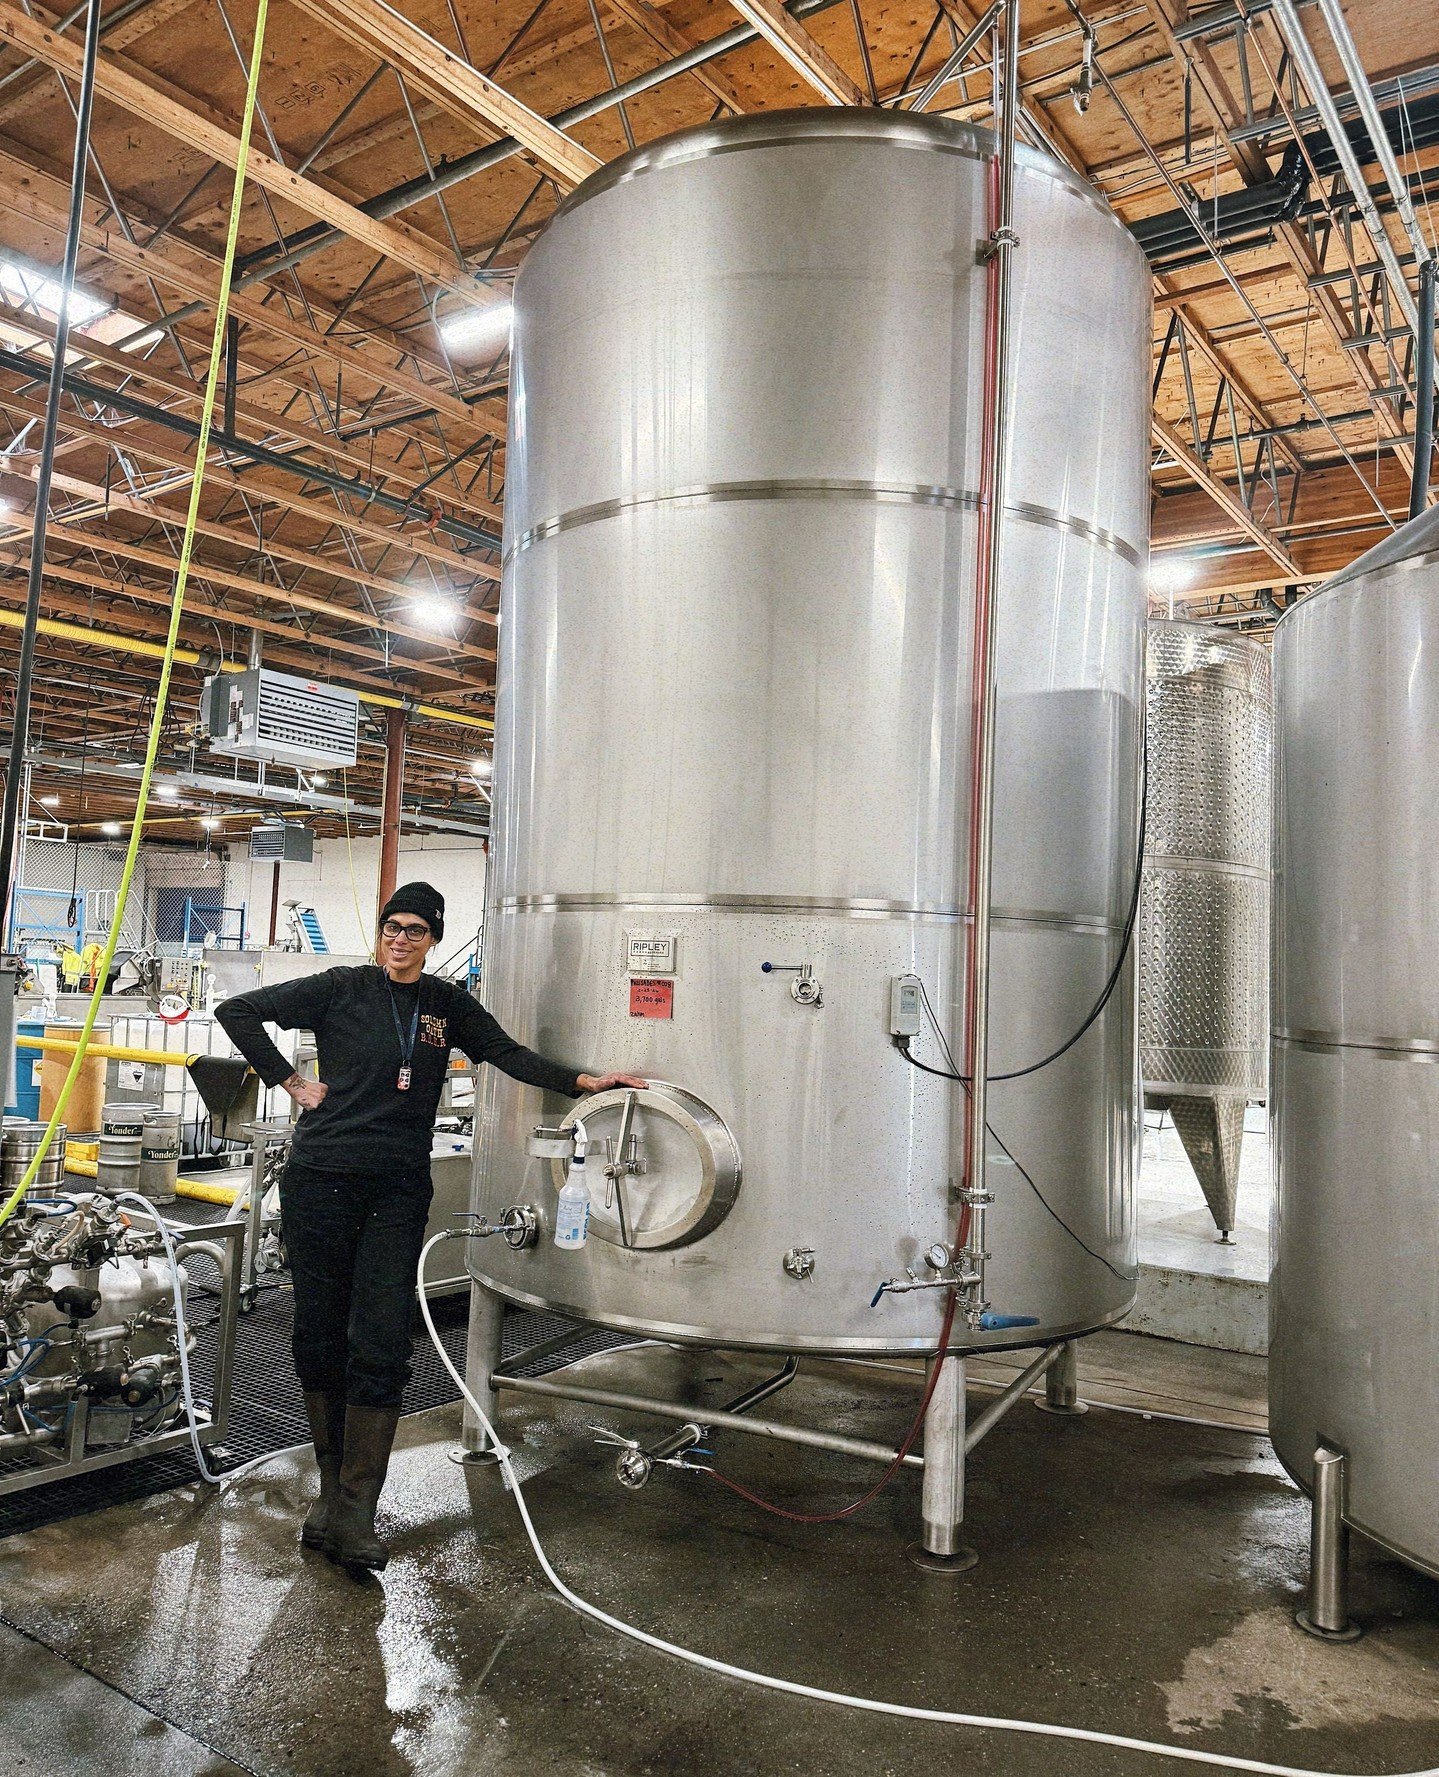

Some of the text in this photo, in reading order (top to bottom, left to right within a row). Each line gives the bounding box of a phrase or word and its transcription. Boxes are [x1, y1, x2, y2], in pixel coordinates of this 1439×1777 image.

[633, 942, 667, 950] RIPLEY
[421, 1015, 447, 1028] SOLEMN
[426, 1024, 443, 1038] OATH
[108, 1123, 138, 1135] Yonder
[147, 1150, 177, 1159] Yonder
